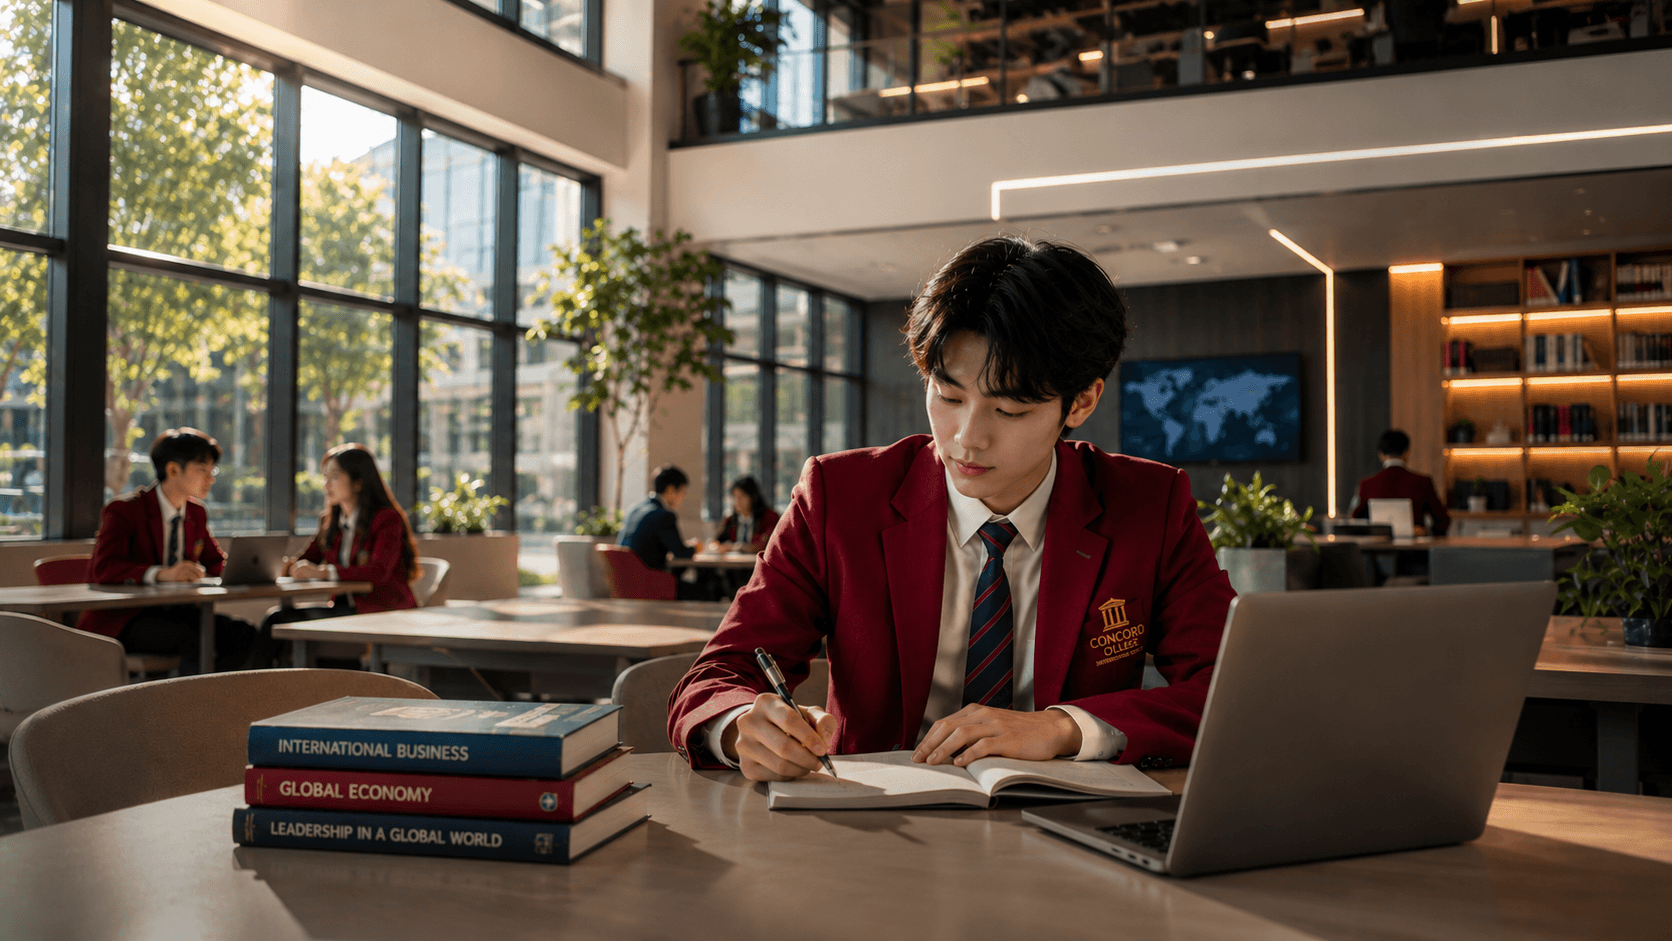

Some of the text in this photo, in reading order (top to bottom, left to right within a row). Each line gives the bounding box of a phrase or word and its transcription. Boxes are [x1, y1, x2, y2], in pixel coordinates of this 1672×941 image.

[278, 738, 470, 762] INTERNATIONAL BUSINESS
[279, 780, 433, 803] GLOBAL ECONOMY
[270, 821, 503, 848] LEADERSHIP IN A GLOBAL WORLD
